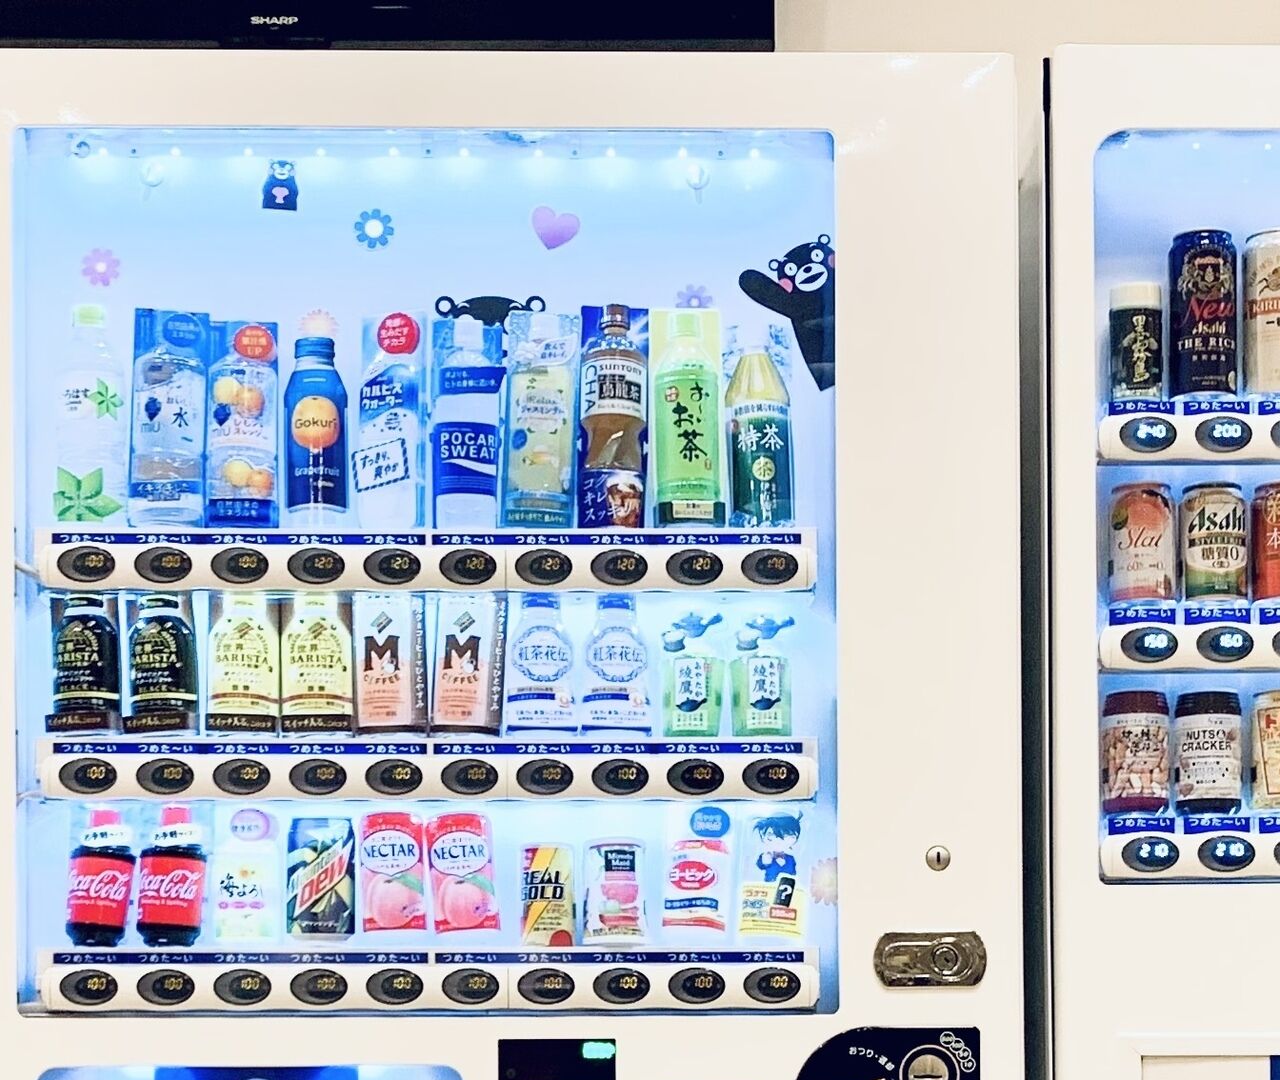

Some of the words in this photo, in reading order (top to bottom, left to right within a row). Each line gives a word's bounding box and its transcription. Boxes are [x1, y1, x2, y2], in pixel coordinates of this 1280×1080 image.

[250, 15, 299, 25] SHARP
[1184, 295, 1236, 322] New
[1192, 320, 1226, 335] Asahi
[1177, 337, 1203, 351] THE
[362, 382, 403, 398] カルピス
[172, 407, 189, 428] 水
[295, 418, 337, 429] Gokuri
[738, 423, 785, 452] 特茶
[440, 445, 496, 460] SWEAT
[1187, 506, 1246, 534] Asahi
[216, 653, 269, 665] BARISTA
[290, 654, 343, 665] BARISTA
[363, 634, 401, 672] M
[442, 634, 482, 672] M
[519, 645, 569, 662] 紅茶花伝
[593, 645, 644, 662] 紅茶花伝
[679, 664, 694, 695] 綾鷹
[753, 664, 768, 694] 綾鷹
[1181, 740, 1232, 753] CRACKER
[363, 844, 416, 858] NECTAR
[433, 844, 486, 860] NECTAR
[521, 867, 565, 885] REAL
[521, 886, 564, 901] GOLD
